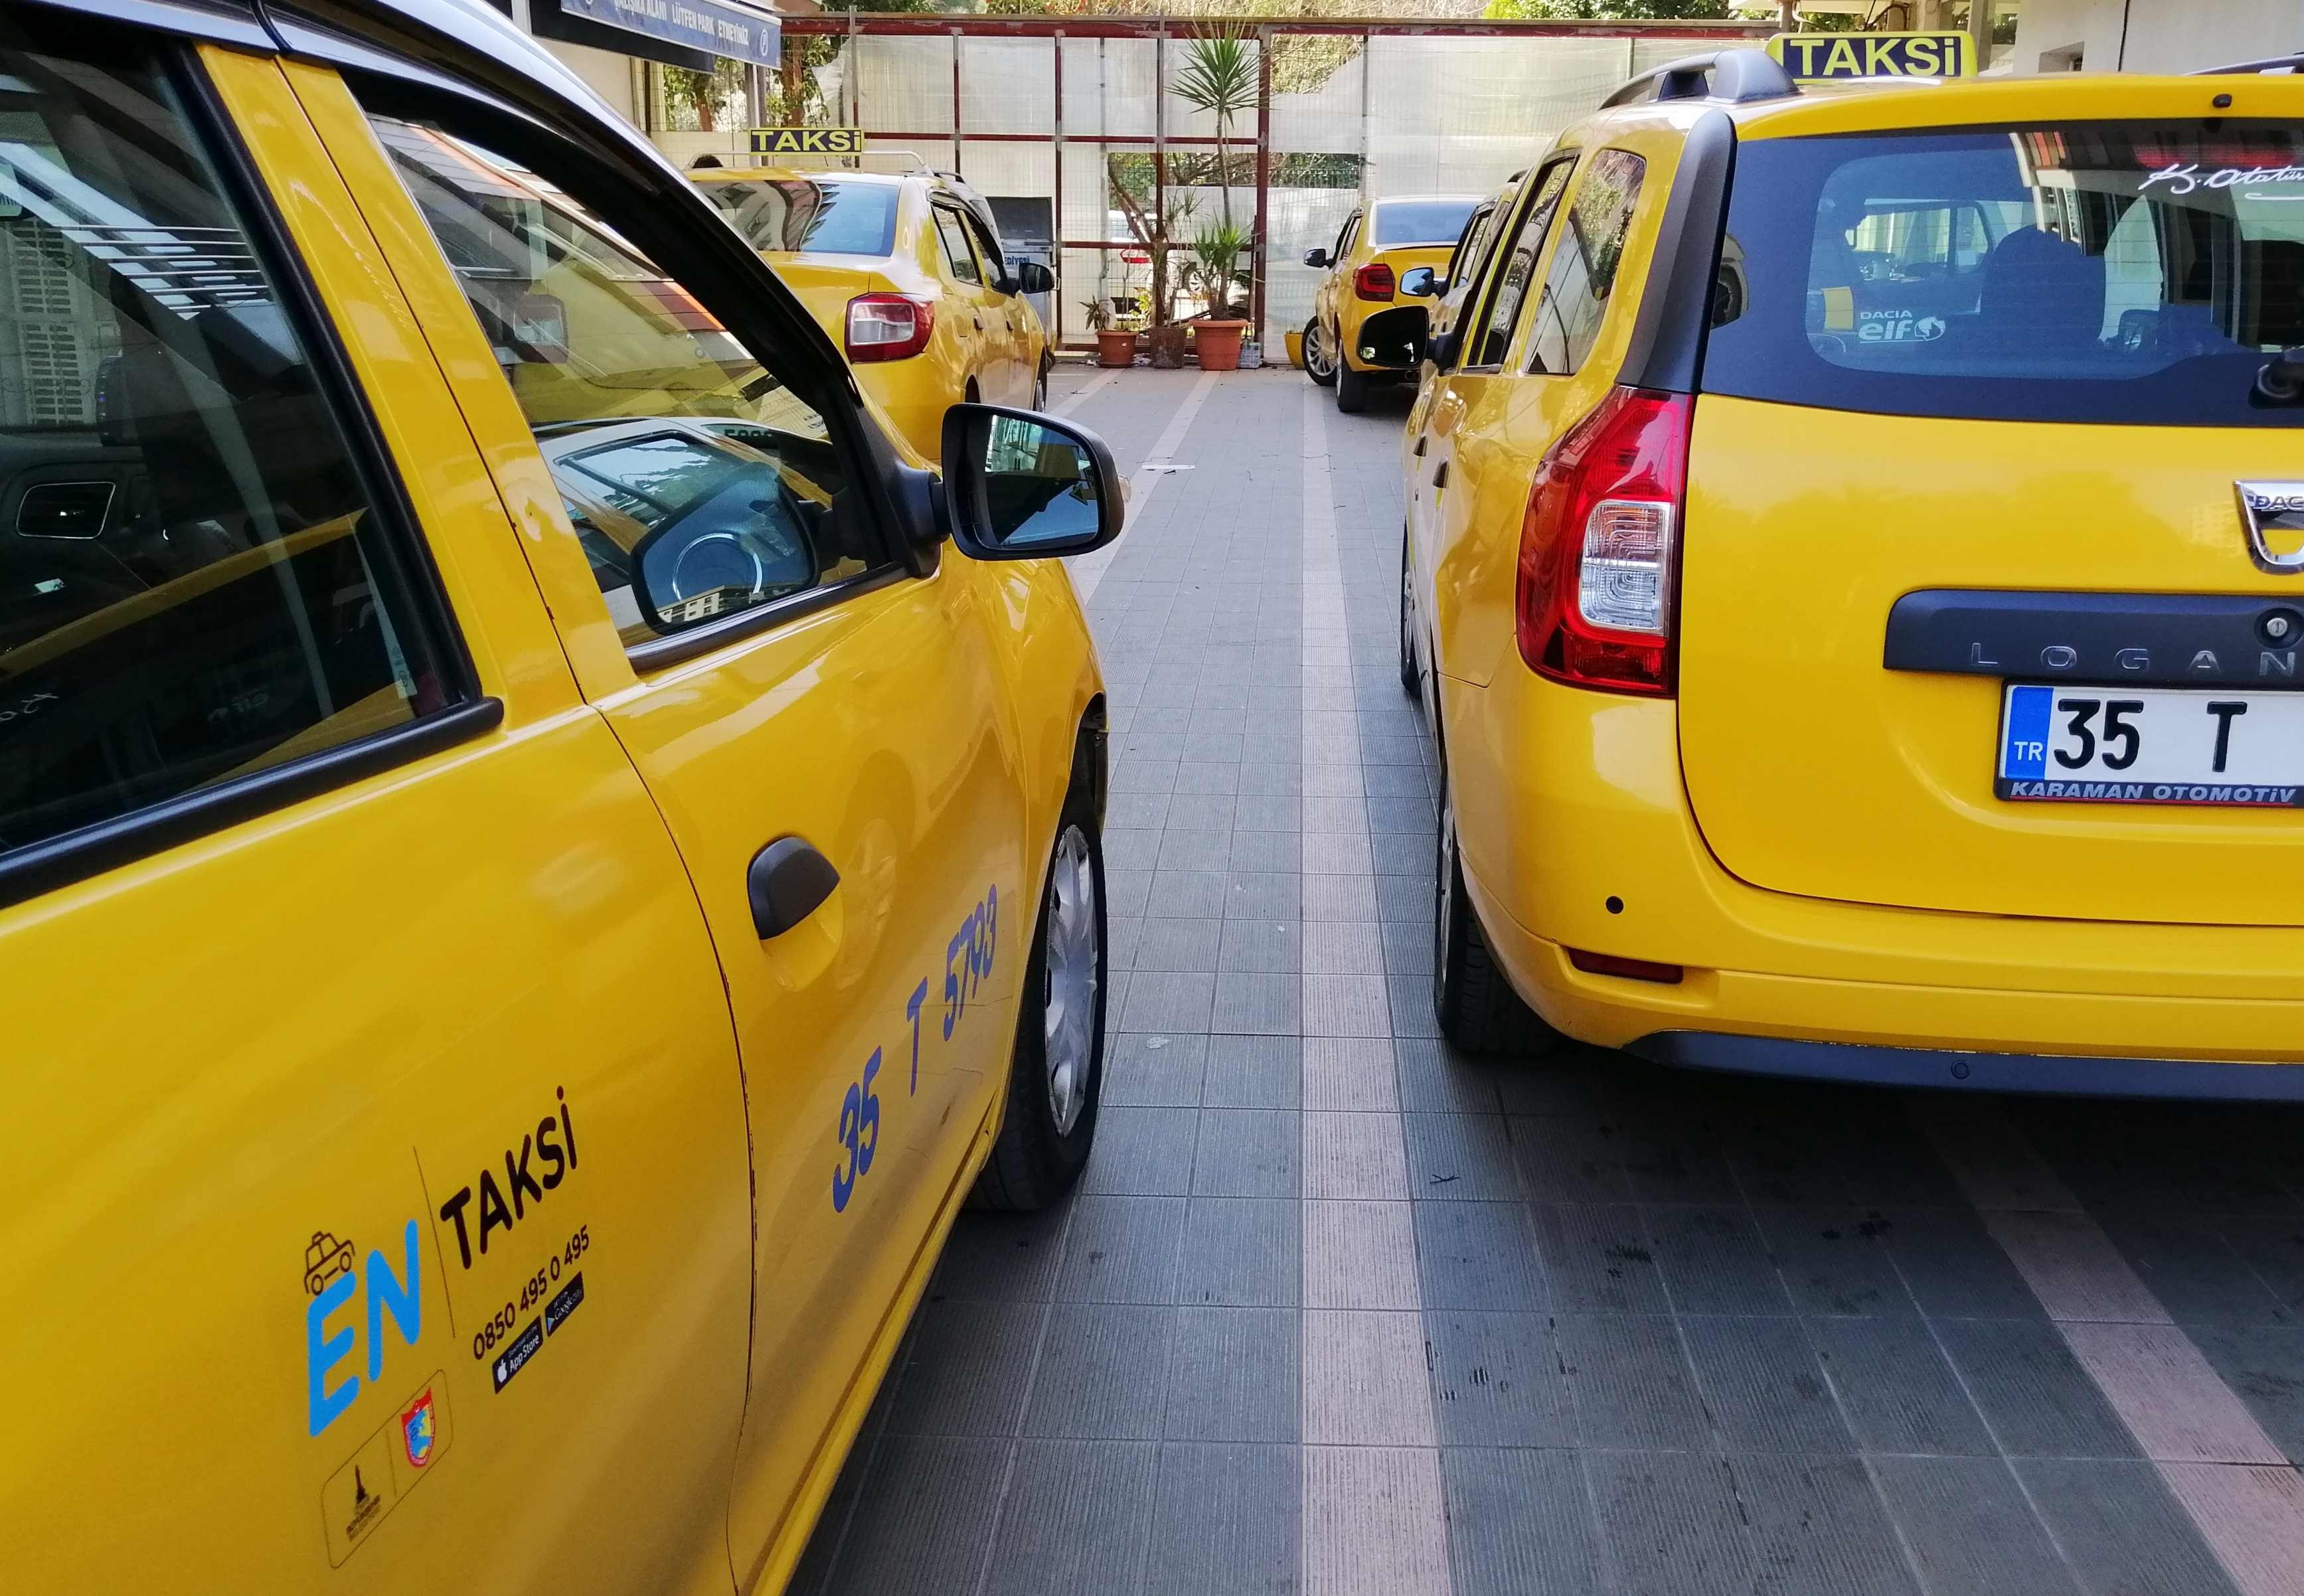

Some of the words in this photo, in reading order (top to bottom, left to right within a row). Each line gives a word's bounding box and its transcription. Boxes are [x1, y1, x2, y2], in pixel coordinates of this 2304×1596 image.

[672, 3, 697, 30] LÜTFEN
[697, 14, 715, 36] PARK
[1859, 319, 1913, 341] elf
[1860, 309, 1913, 320] DACIA
[1970, 642, 2295, 677] LOGAN
[2013, 741, 2043, 762] TR
[2053, 698, 2145, 771] 35
[2206, 701, 2248, 773] T
[2011, 781, 2144, 800] KARAMAN
[832, 1044, 882, 1214] 35
[906, 975, 928, 1097] T
[942, 883, 997, 1042] 5793
[473, 1301, 516, 1360] 0850
[520, 1267, 547, 1312] 495
[550, 1255, 560, 1281] 0
[564, 1224, 589, 1265] 495
[305, 1218, 420, 1438] EN
[509, 1352, 523, 1373] App
[523, 1334, 539, 1358] Store
